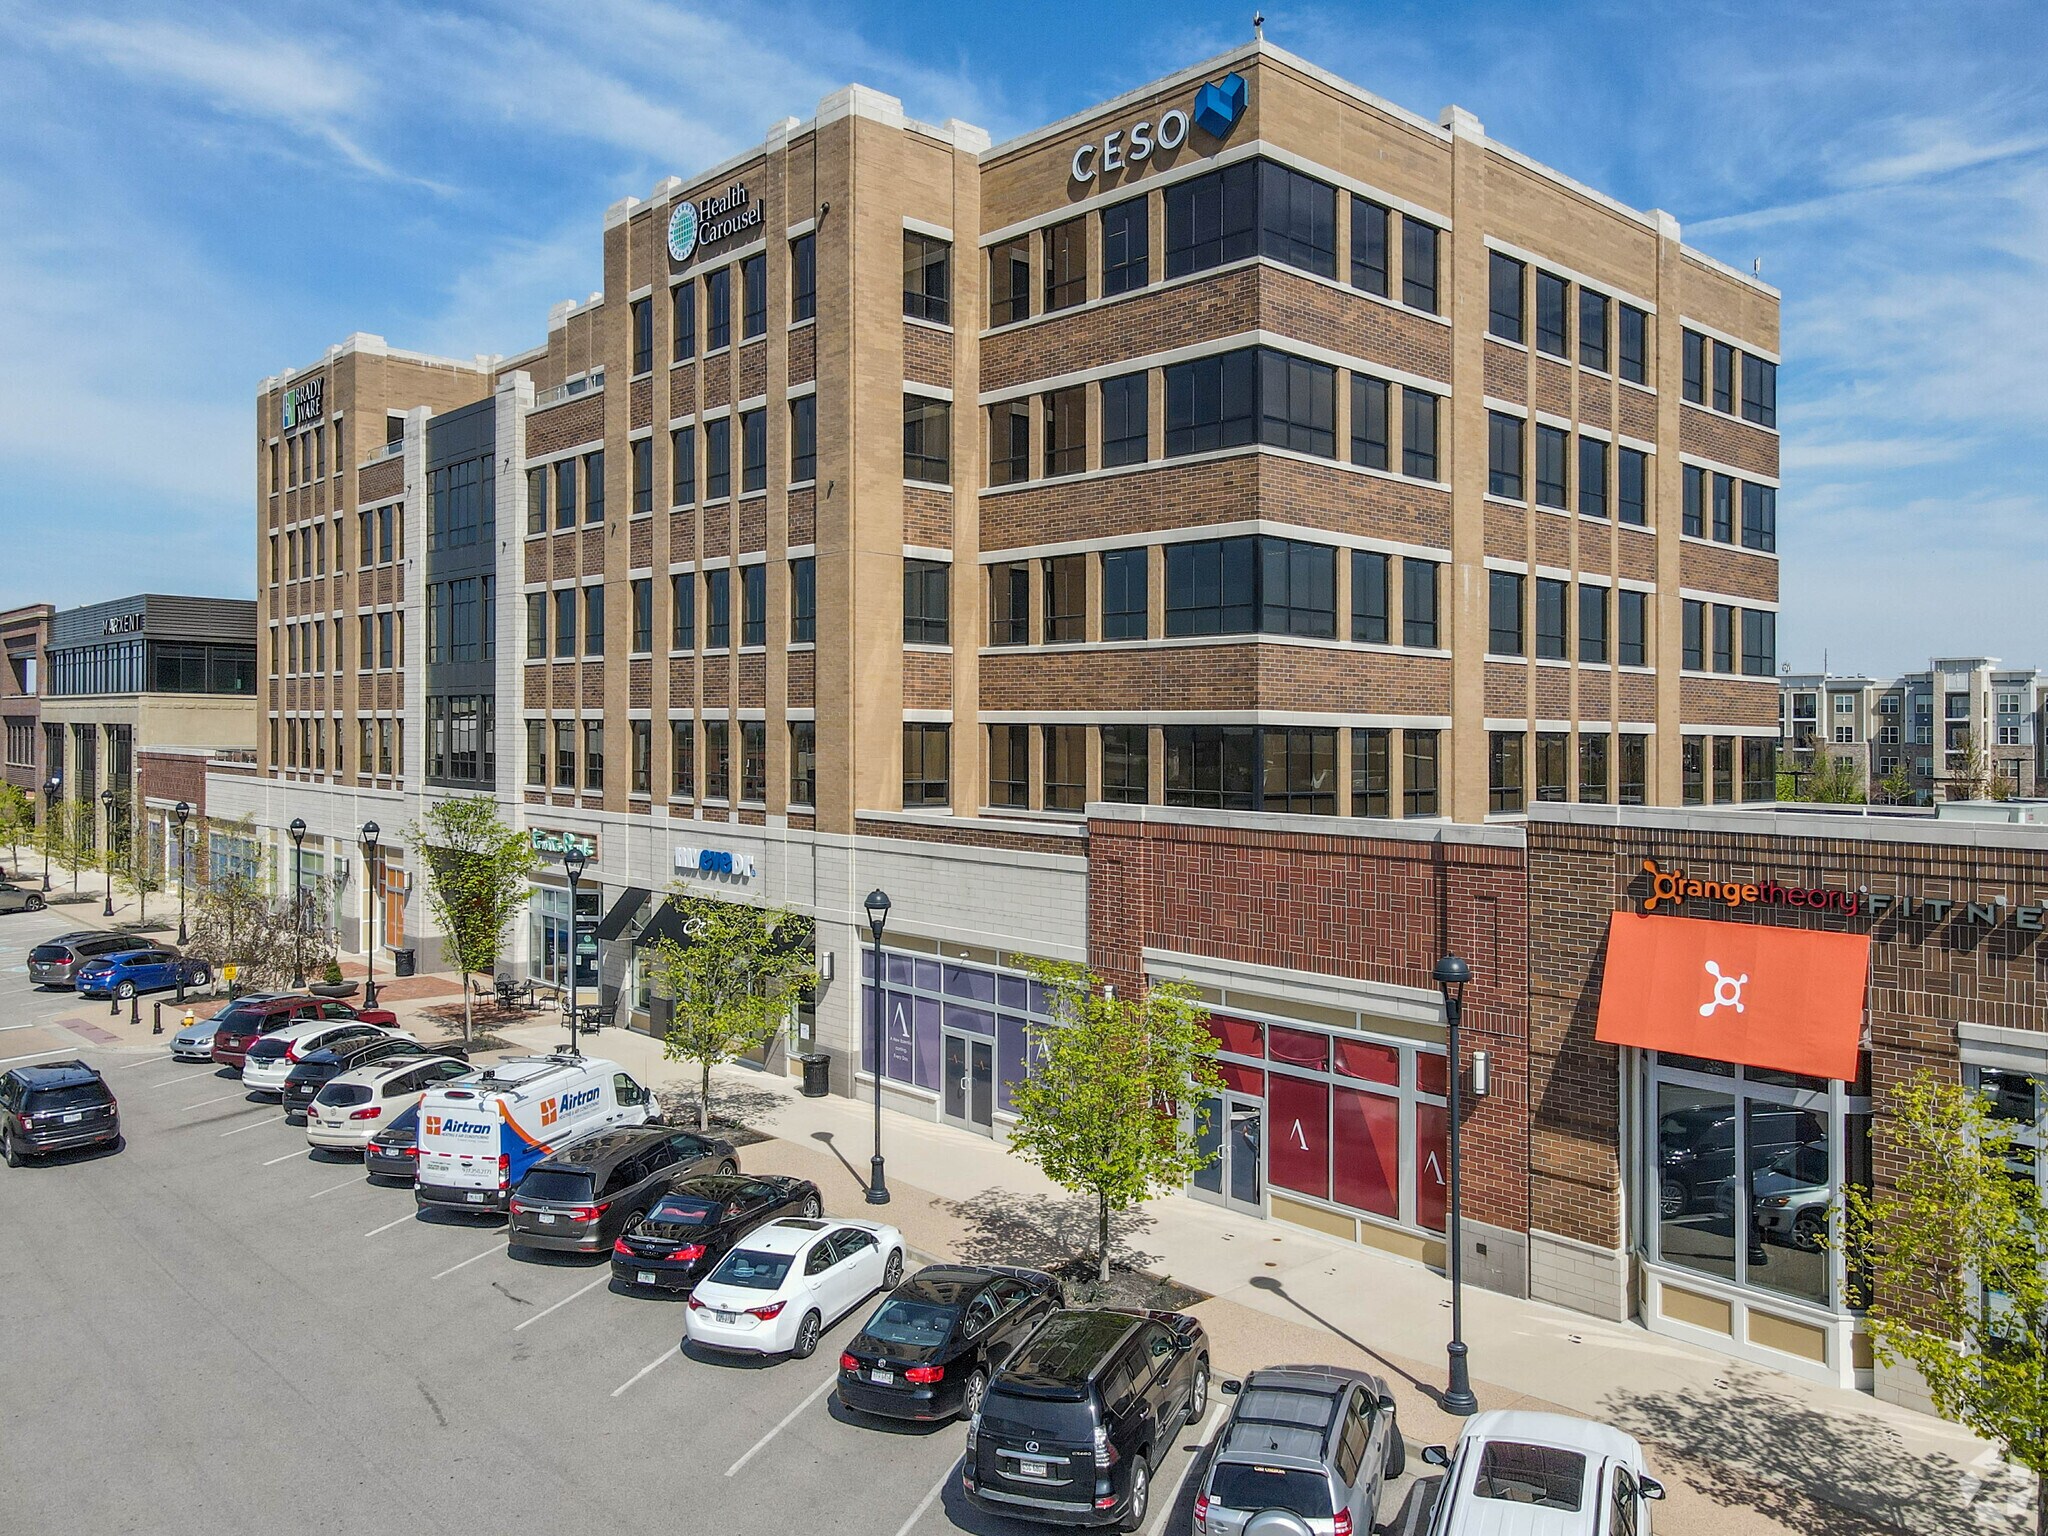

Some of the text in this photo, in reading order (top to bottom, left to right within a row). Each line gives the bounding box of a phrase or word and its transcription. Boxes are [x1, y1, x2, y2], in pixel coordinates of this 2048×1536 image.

[1072, 109, 1189, 182] CESO
[699, 182, 746, 223] Health
[699, 199, 762, 245] Carousel
[295, 377, 322, 406] BRADY
[297, 396, 321, 423] WARE
[102, 613, 140, 635] MARXENT
[559, 1087, 600, 1114] Airtron
[442, 1118, 491, 1135] Airtron
